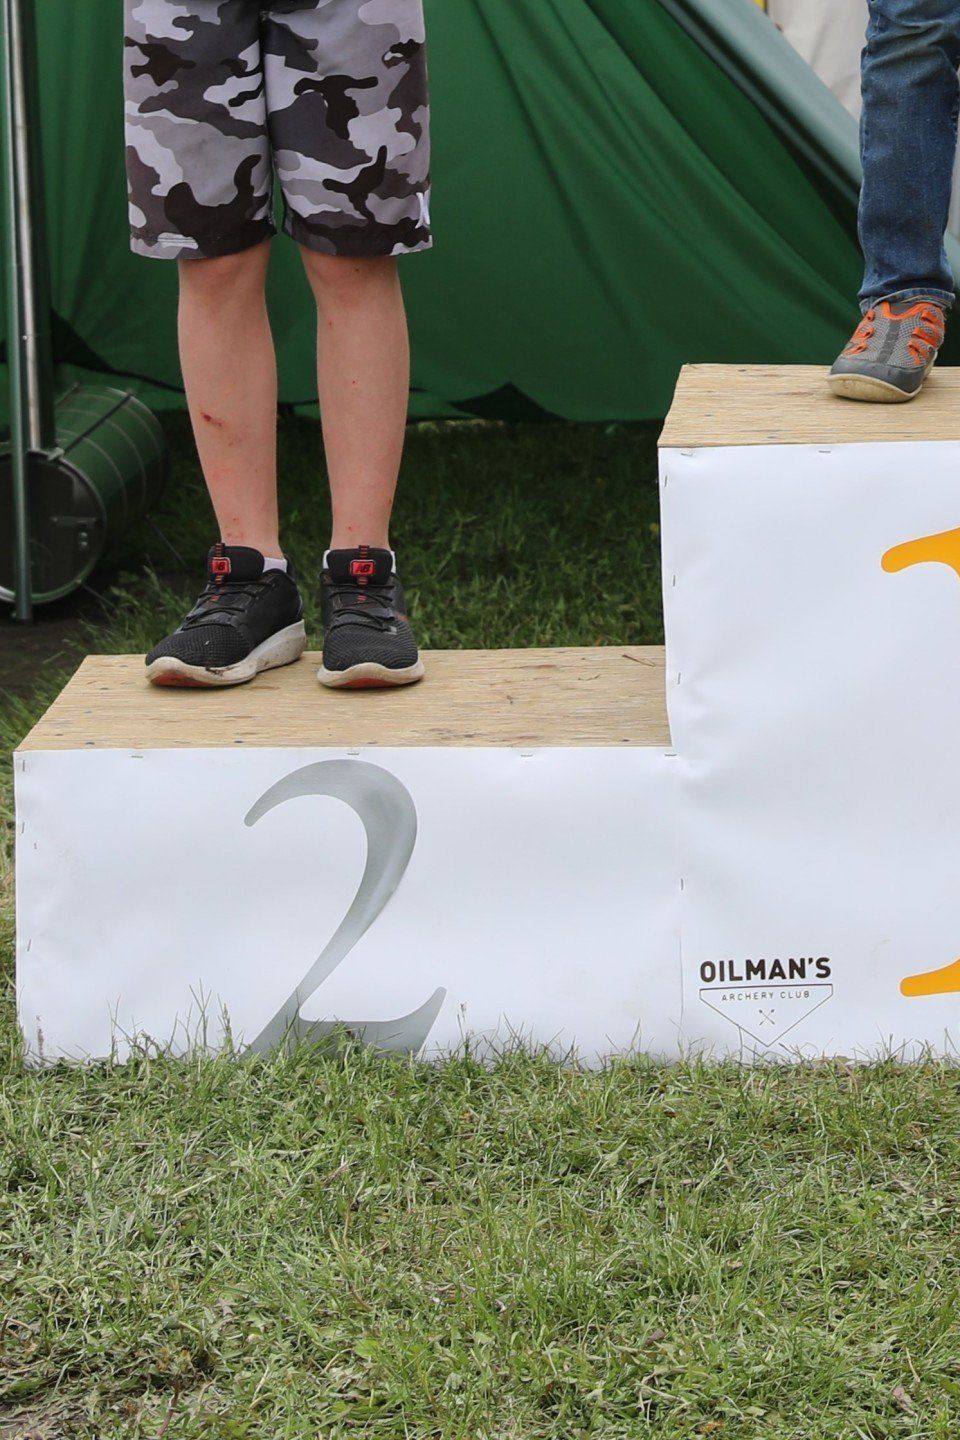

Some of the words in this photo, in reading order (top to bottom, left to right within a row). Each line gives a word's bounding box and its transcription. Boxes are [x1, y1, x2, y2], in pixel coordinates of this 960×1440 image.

[243, 759, 447, 1058] 2
[700, 957, 832, 983] OILMAN'S
[721, 991, 774, 1001] ARCHERY
[780, 990, 810, 999] CLUB
